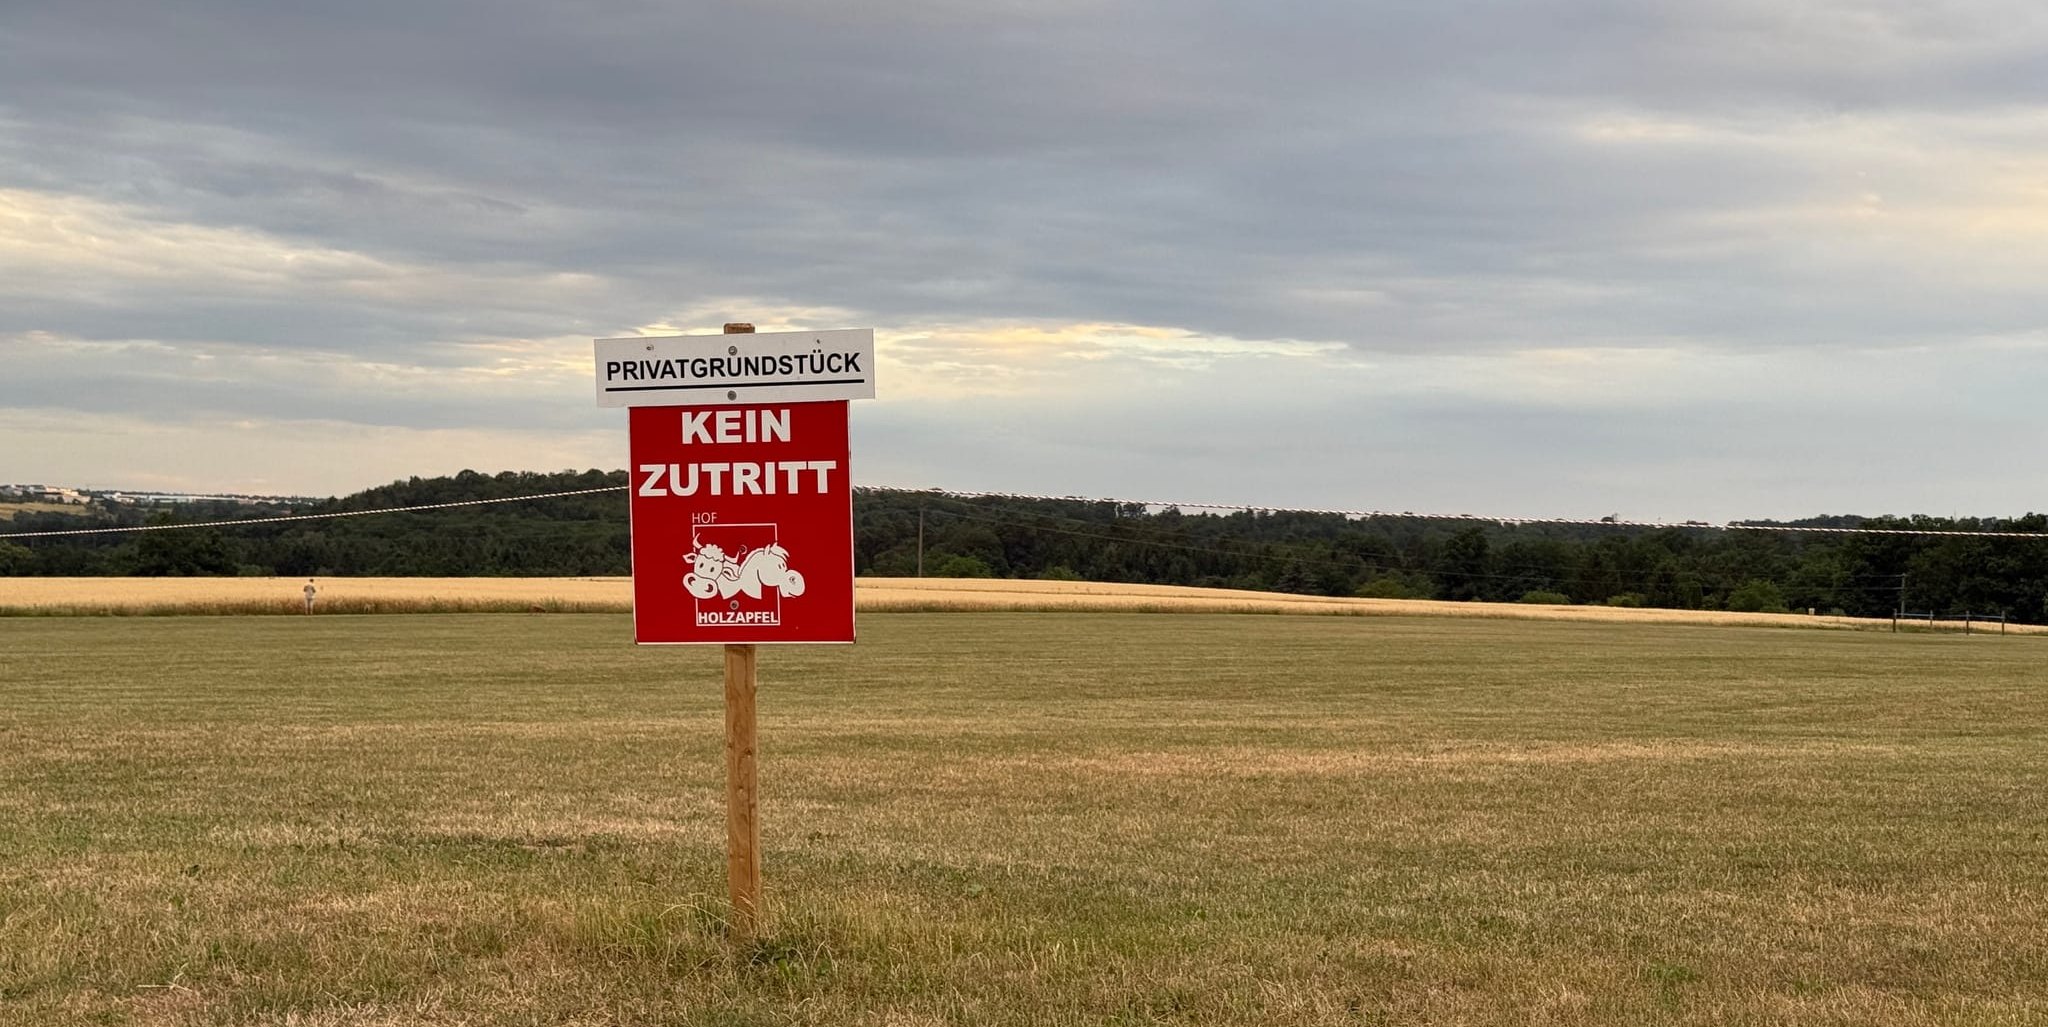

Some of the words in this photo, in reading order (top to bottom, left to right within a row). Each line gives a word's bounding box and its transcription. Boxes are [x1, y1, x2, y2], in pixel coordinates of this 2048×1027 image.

[606, 349, 861, 381] PRIVATGRUNDSTÜCK
[681, 409, 791, 445] KEIN
[638, 460, 837, 497] ZUTRITT
[692, 512, 718, 524] HOF
[698, 611, 779, 624] HOLZAPFEL
